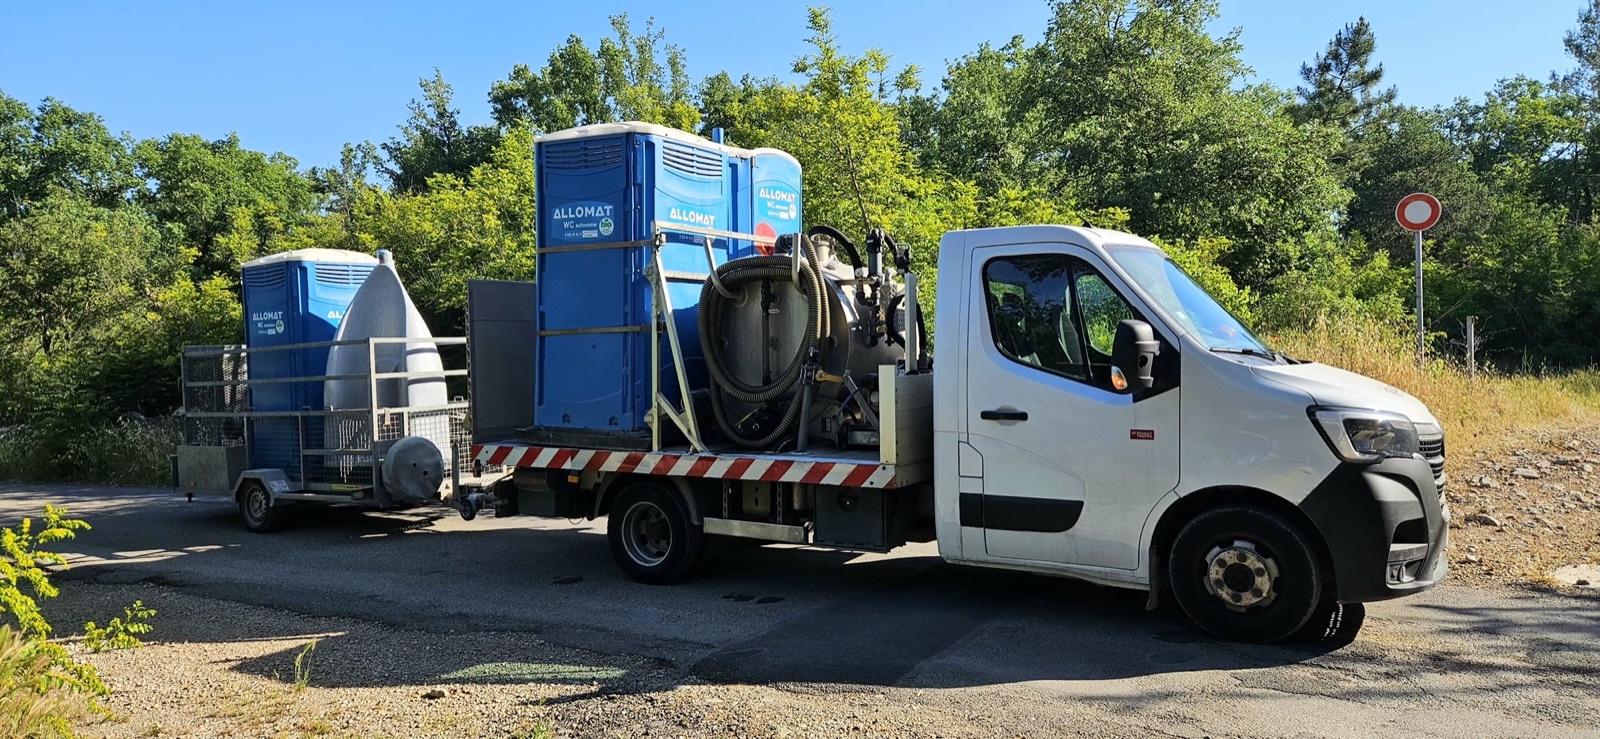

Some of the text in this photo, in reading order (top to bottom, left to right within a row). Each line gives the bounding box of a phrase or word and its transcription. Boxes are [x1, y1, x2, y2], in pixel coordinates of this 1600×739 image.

[759, 187, 795, 202] ALLOMAT
[553, 206, 613, 219] ALLOMAT
[670, 207, 715, 225] ALLOMAT
[563, 221, 575, 229] WC
[253, 311, 283, 321] ALLOMAT
